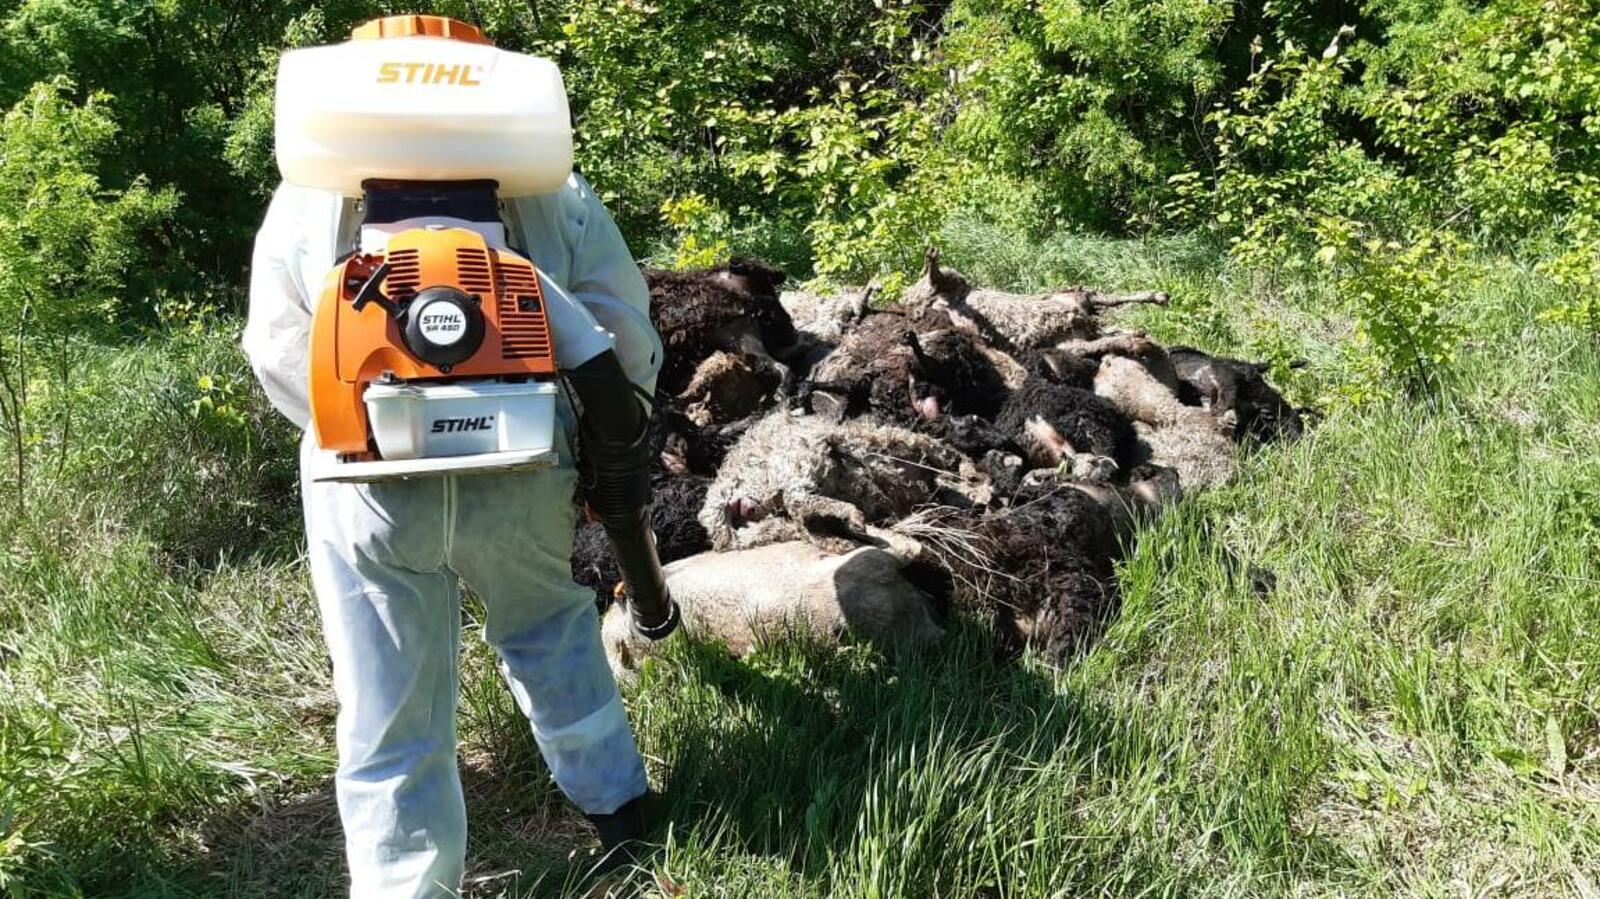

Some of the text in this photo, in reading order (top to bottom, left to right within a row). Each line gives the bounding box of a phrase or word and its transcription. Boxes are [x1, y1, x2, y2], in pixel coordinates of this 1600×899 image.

[376, 62, 481, 86] STIHL
[422, 314, 462, 325] STIHL
[430, 416, 492, 433] STIHL
